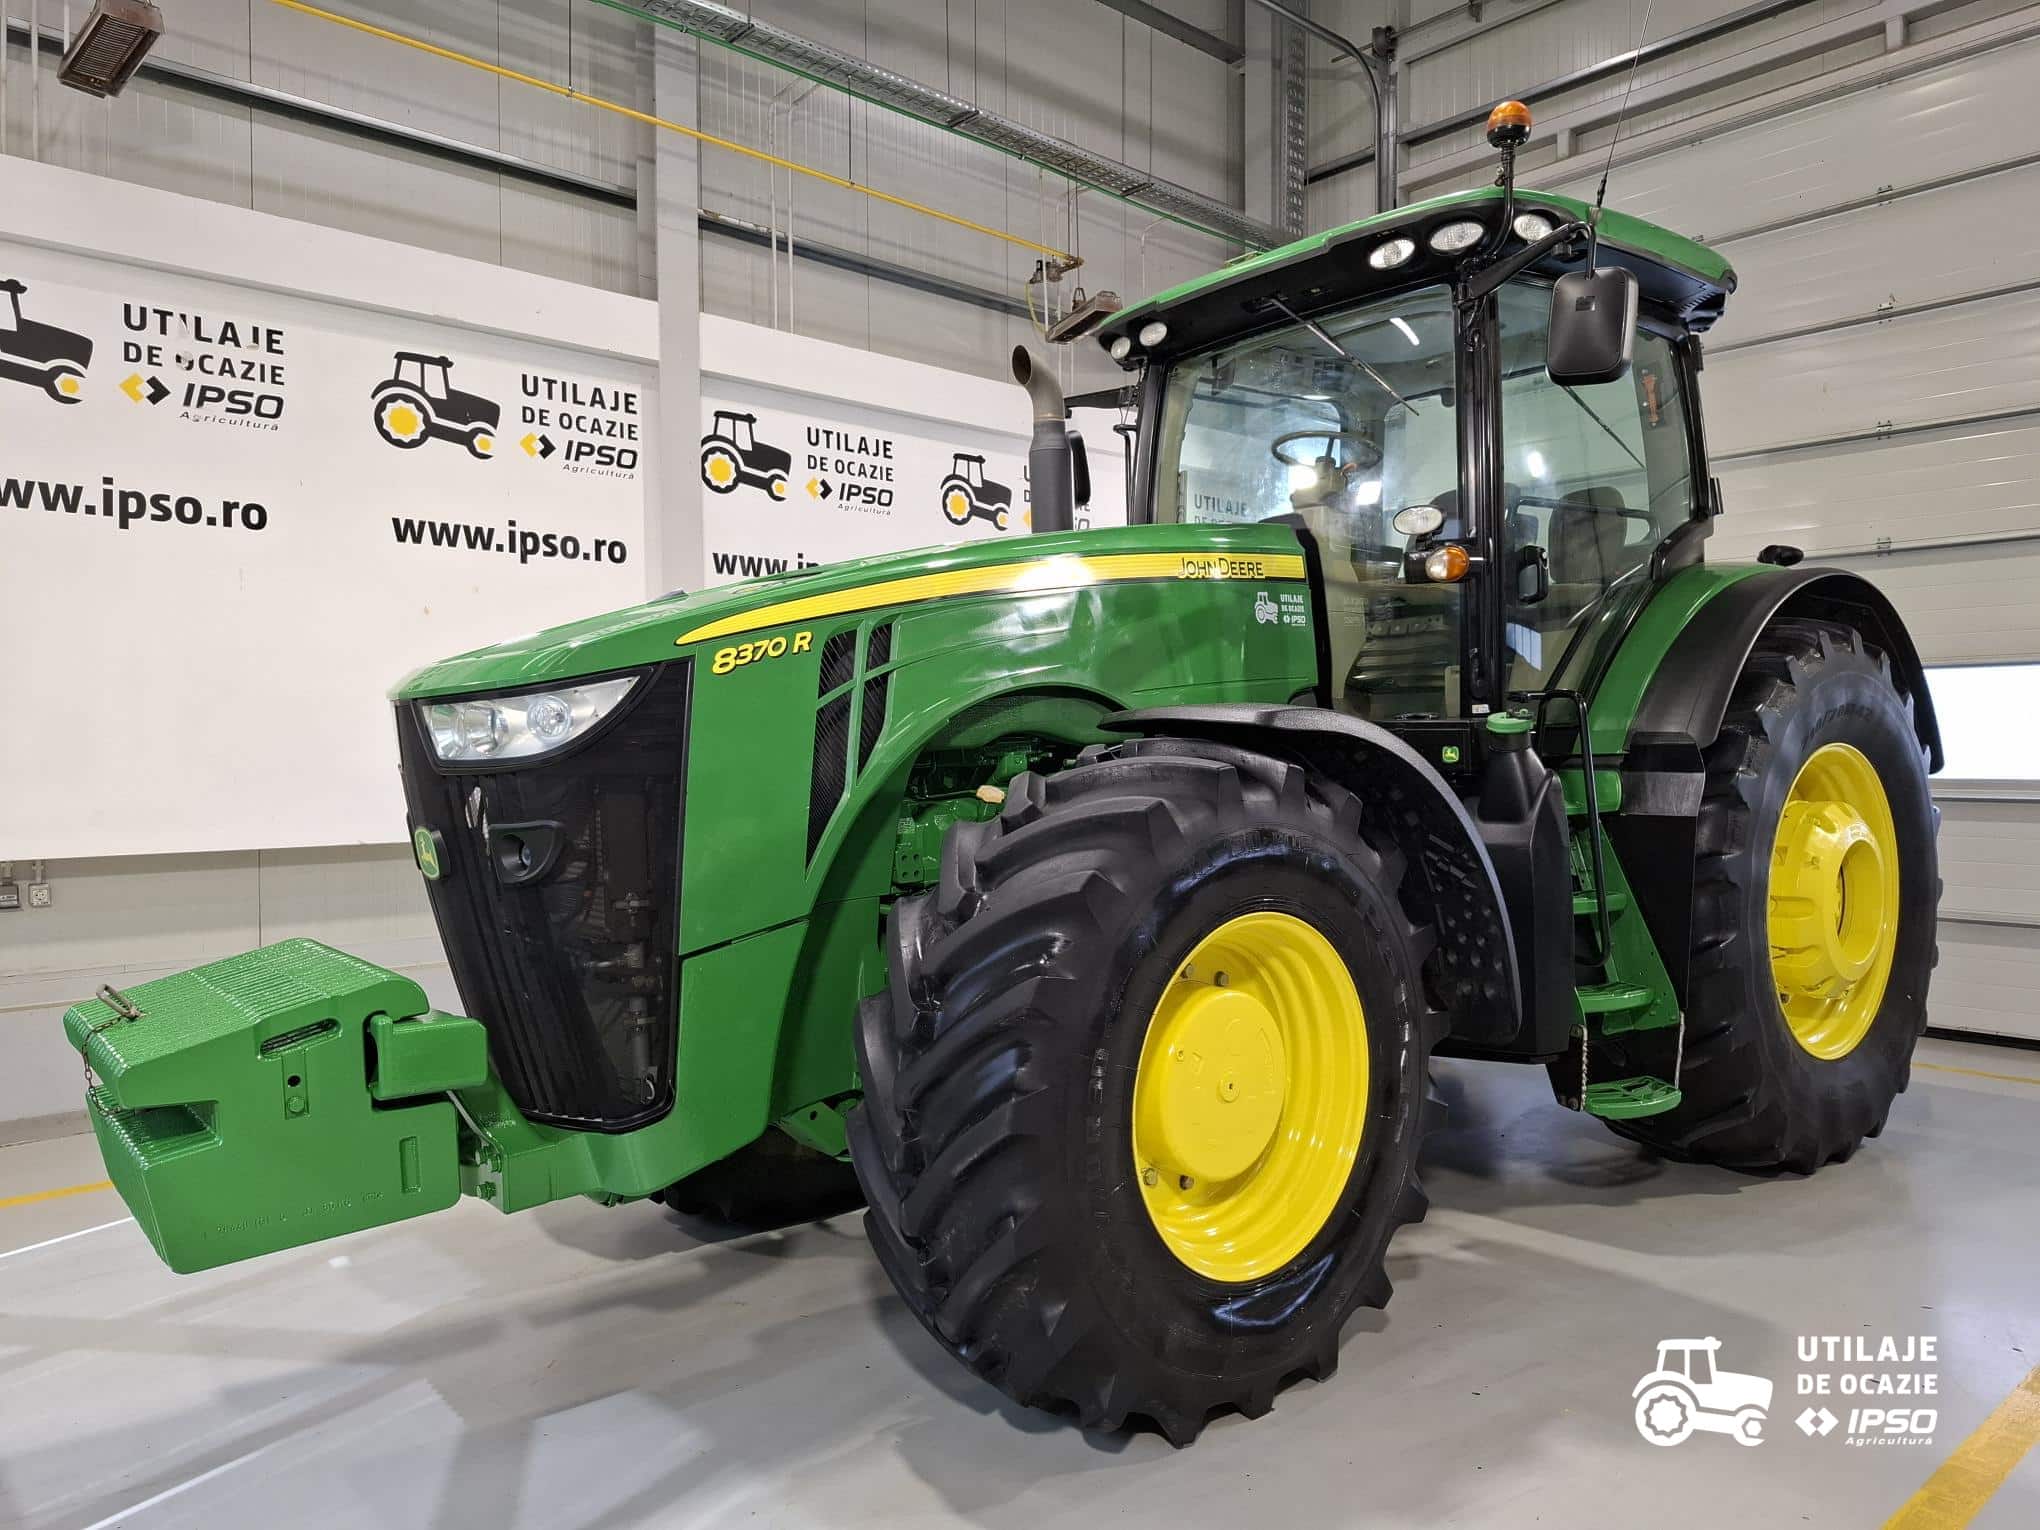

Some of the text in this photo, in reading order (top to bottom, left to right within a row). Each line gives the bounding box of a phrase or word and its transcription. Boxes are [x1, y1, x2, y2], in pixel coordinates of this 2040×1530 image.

[123, 341, 163, 367] DE
[183, 383, 284, 419] IPSO
[521, 373, 638, 415] UTILAJE
[521, 406, 639, 441] DE OCAZIE
[565, 440, 638, 469] IPSO
[807, 426, 893, 459] UTILAJE
[807, 454, 894, 482] DE OCAZIE
[839, 483, 893, 507] IPSO
[1194, 494, 1248, 517] UTILAJE
[391, 517, 628, 565] www.ipso.ro
[712, 552, 819, 578] wwwi
[1178, 557, 1264, 576] JOHN DEERE
[712, 631, 813, 675] 8370 R
